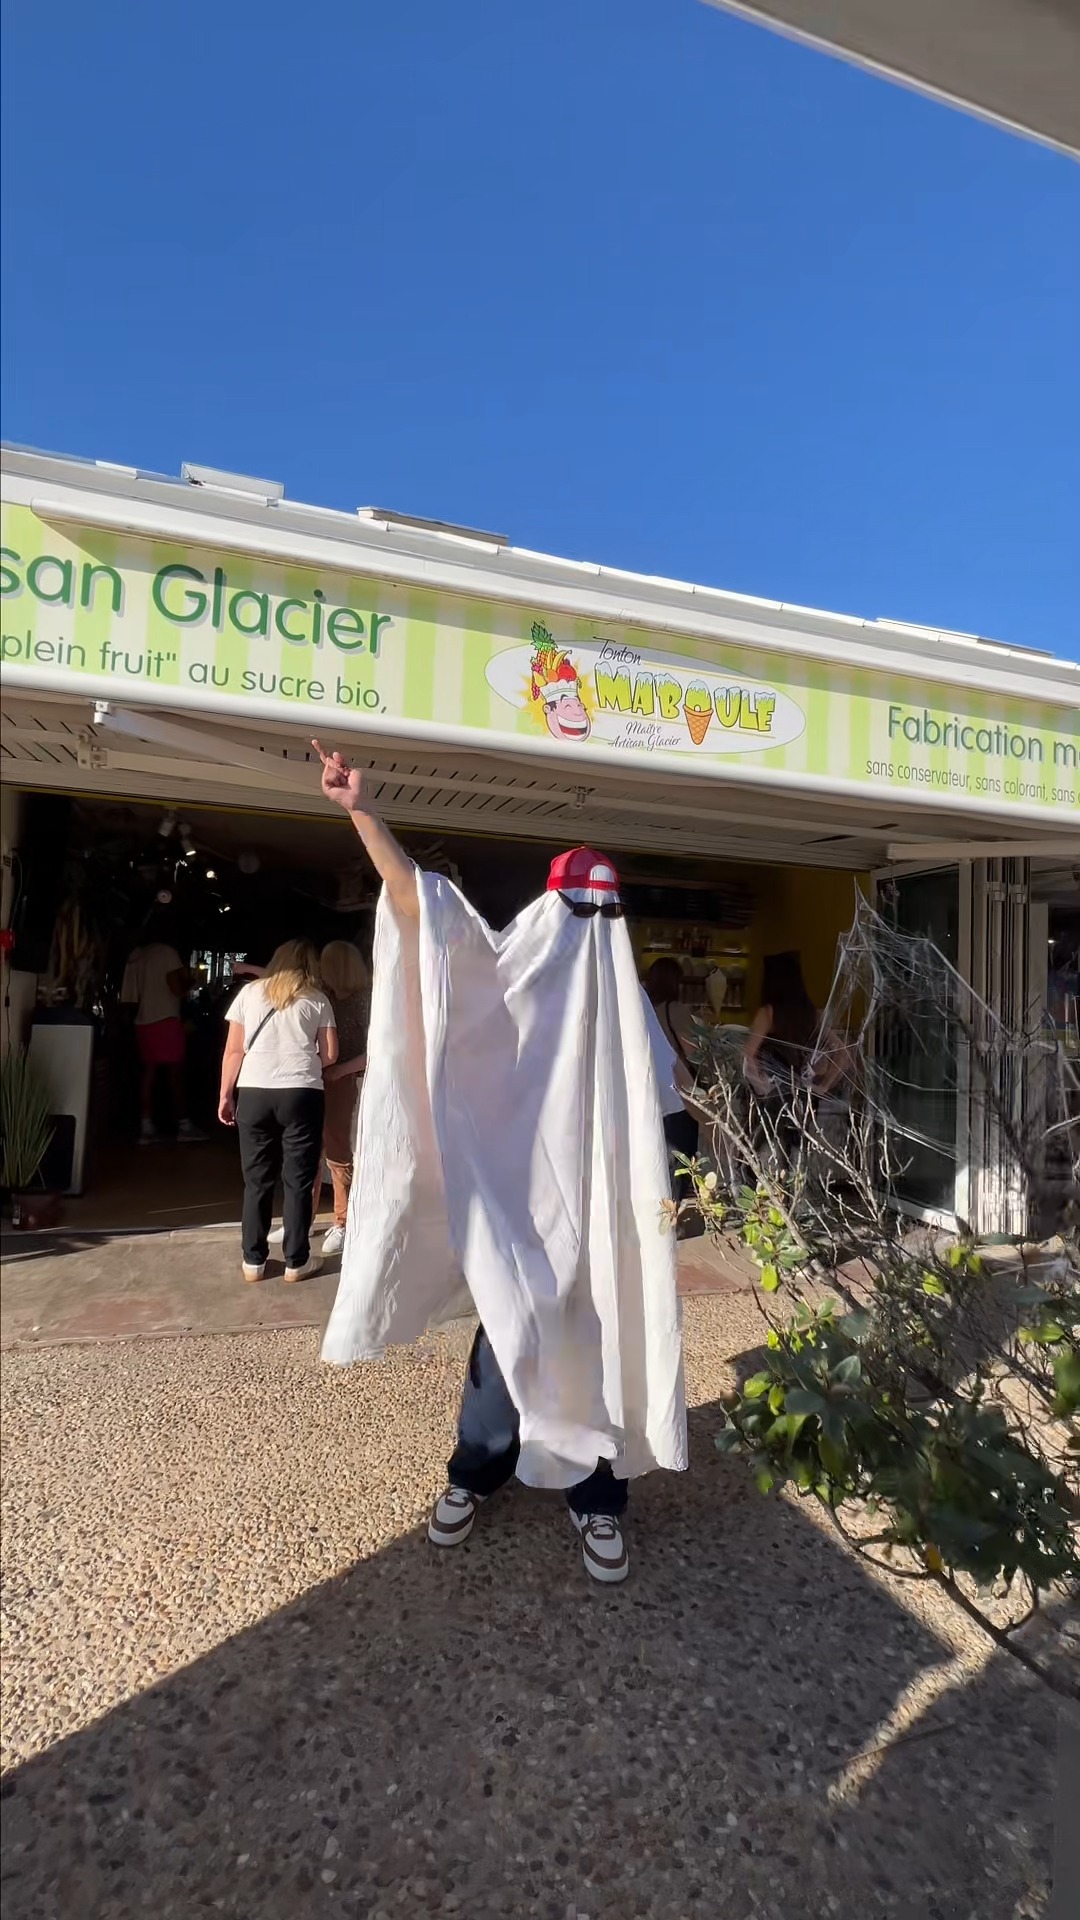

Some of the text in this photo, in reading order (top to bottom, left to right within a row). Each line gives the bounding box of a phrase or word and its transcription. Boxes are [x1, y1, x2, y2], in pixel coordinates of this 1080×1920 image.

[152, 563, 393, 655] Glacier
[1, 629, 387, 714] plein fruit" au sucre bio,
[592, 636, 642, 666] Tonton
[594, 661, 776, 745] MABOULE
[608, 733, 682, 752] Artisan Glacier
[888, 705, 1080, 768] Fabrication m
[866, 760, 894, 776] sans
[897, 764, 972, 791] conservateur,
[975, 774, 1001, 793] sans
[1003, 777, 1048, 801] colorant,
[1051, 787, 1076, 803] sans
